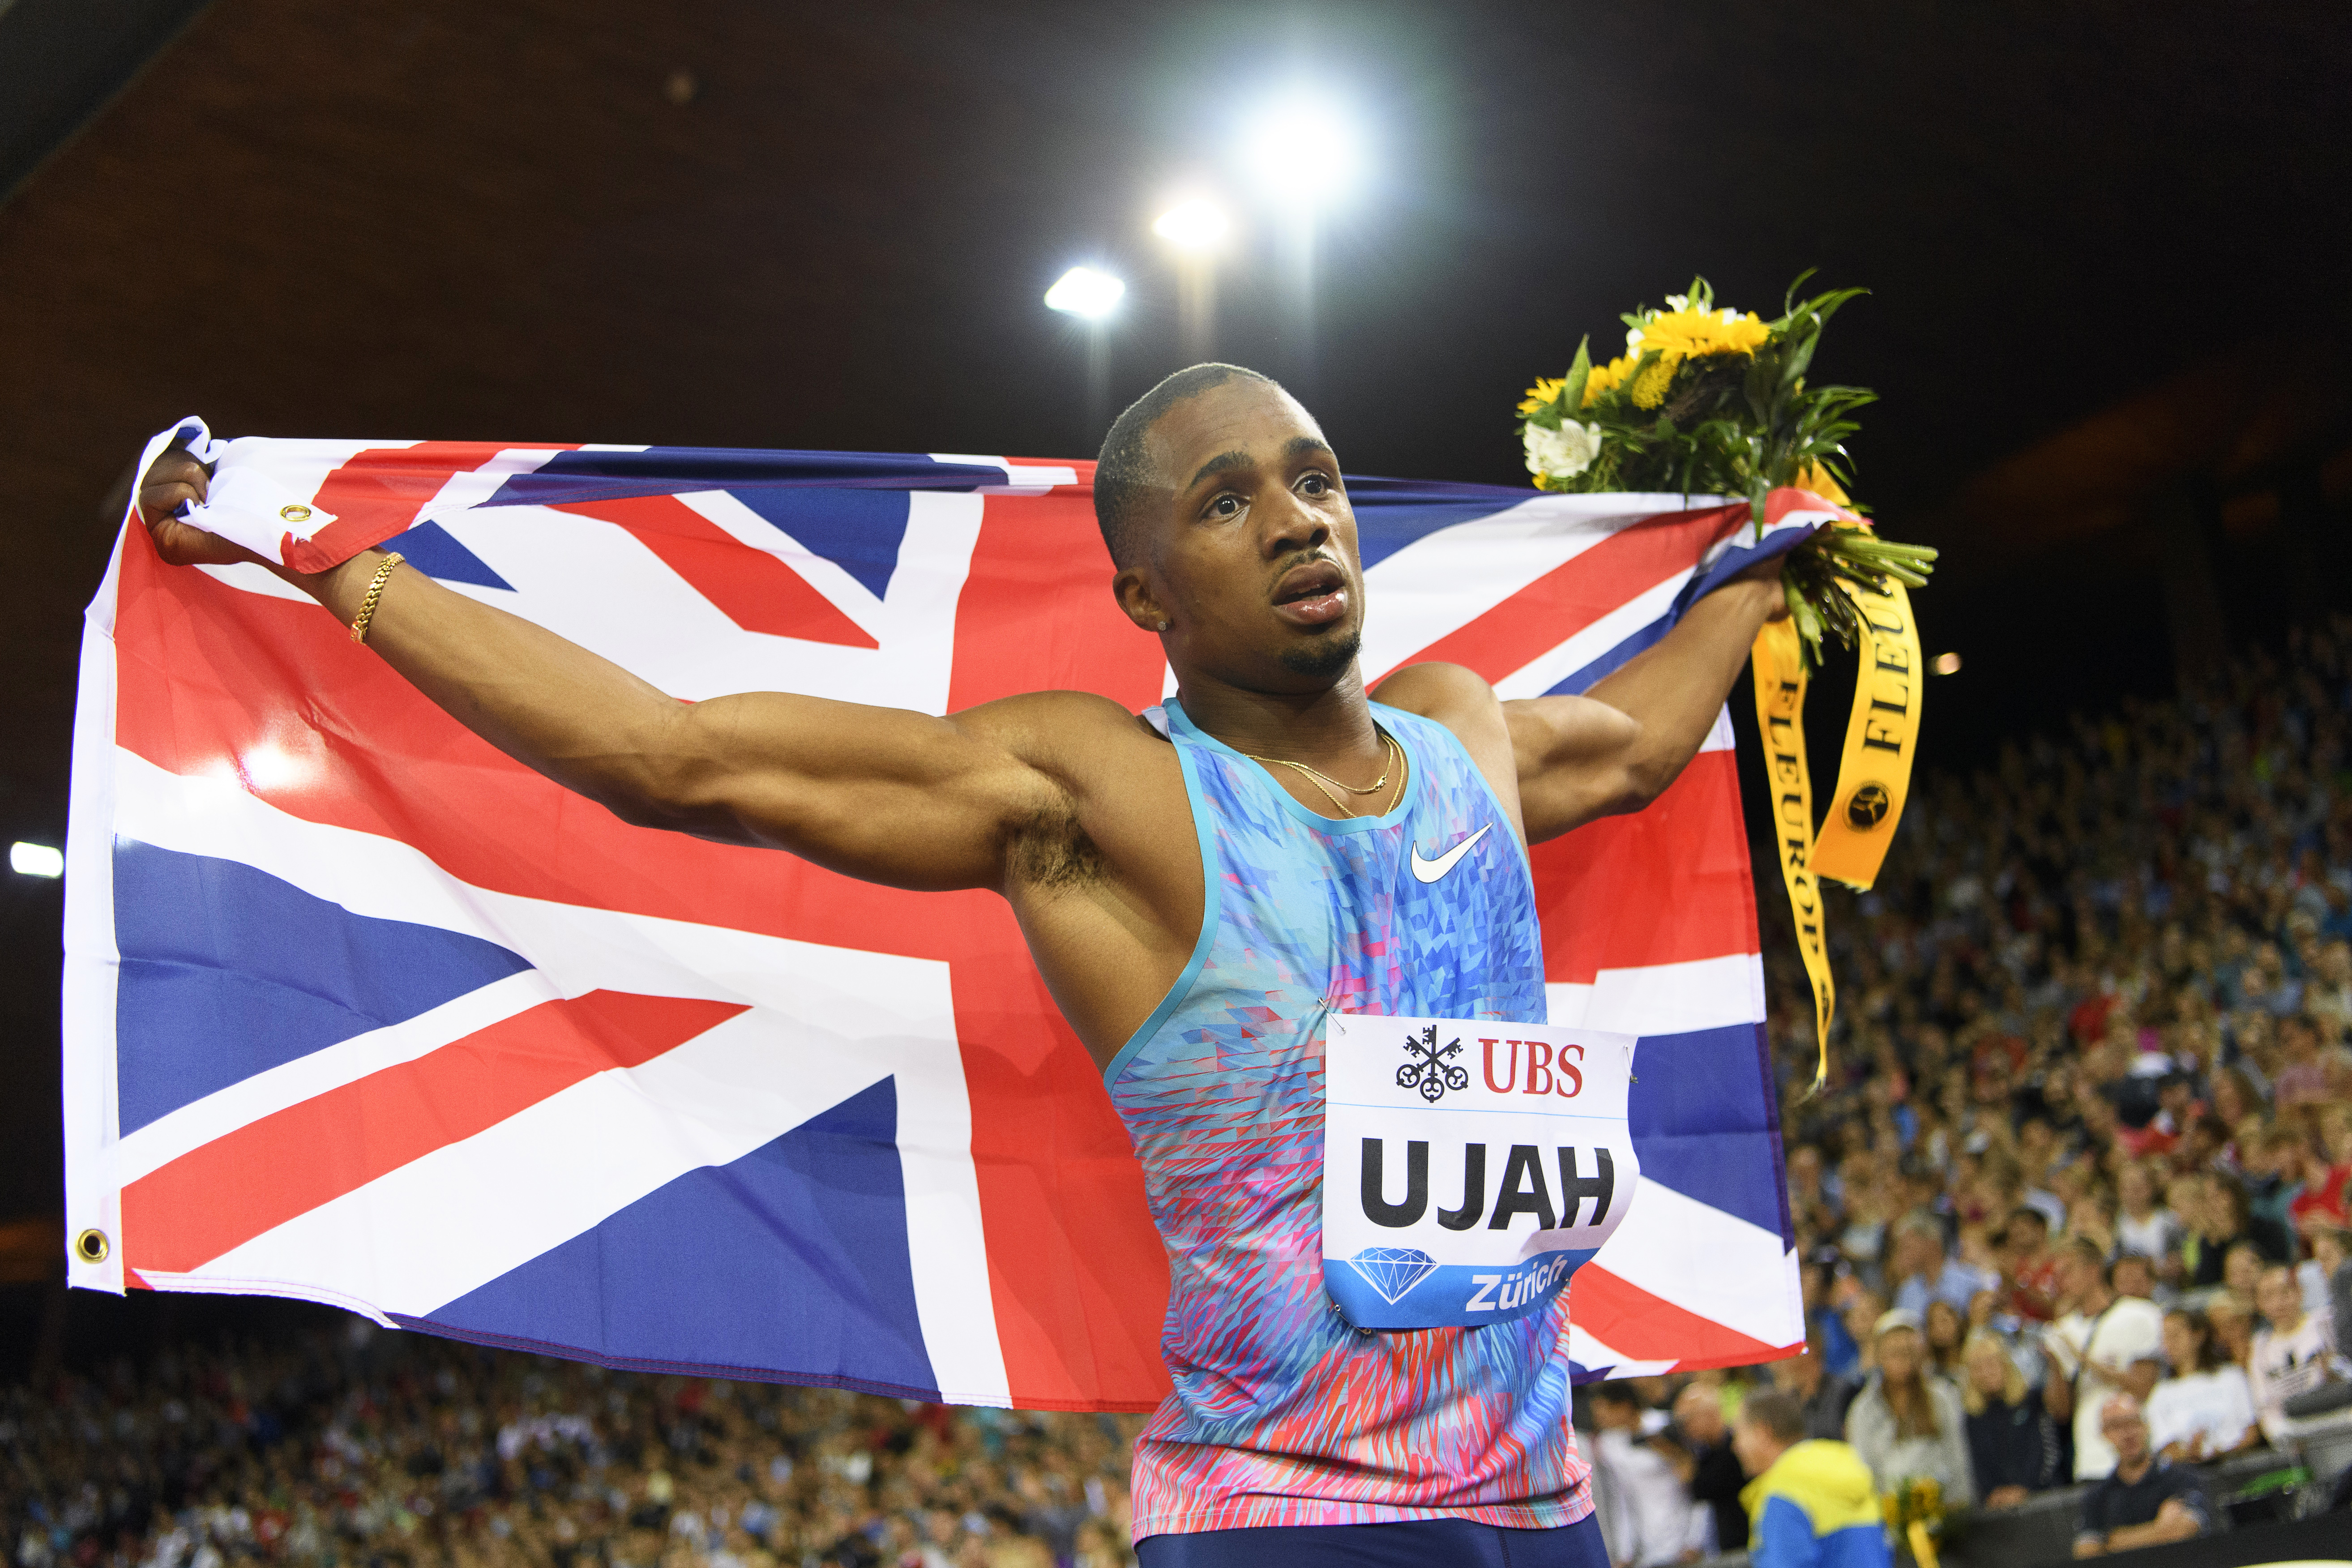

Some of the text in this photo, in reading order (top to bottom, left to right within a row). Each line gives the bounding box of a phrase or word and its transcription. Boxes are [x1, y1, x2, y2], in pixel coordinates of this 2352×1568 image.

[1478, 1038, 1585, 1098] UBS
[1361, 1137, 1614, 1231] UJAH
[1465, 1256, 1568, 1312] Zürich
